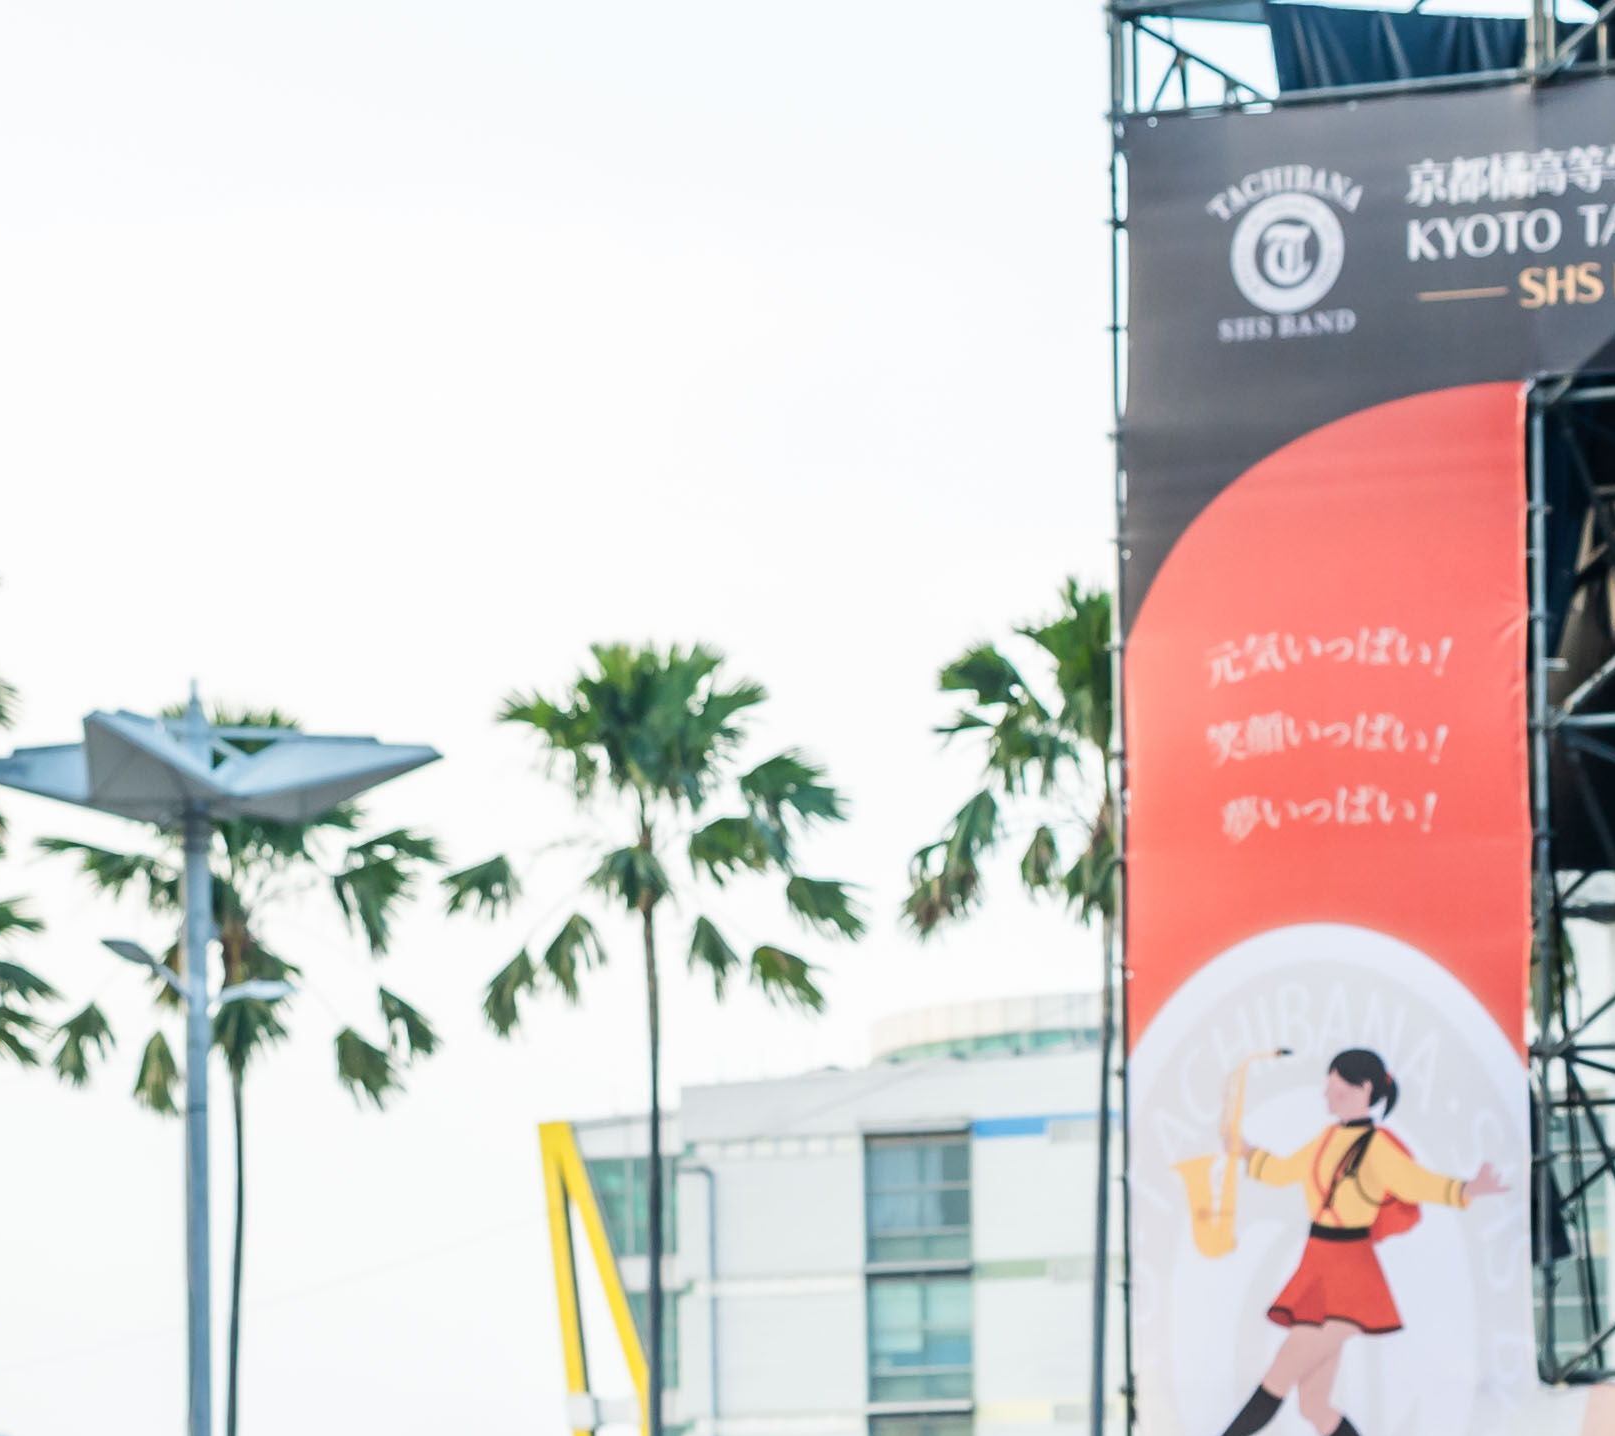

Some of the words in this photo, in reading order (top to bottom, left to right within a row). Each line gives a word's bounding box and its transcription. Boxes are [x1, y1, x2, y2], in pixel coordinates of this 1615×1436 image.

[1205, 164, 1364, 222] TACHIBANA
[1406, 208, 1563, 262] KYOTO
[1518, 261, 1605, 309] SHS
[1217, 315, 1273, 343] SHS
[1278, 308, 1357, 339] BAND
